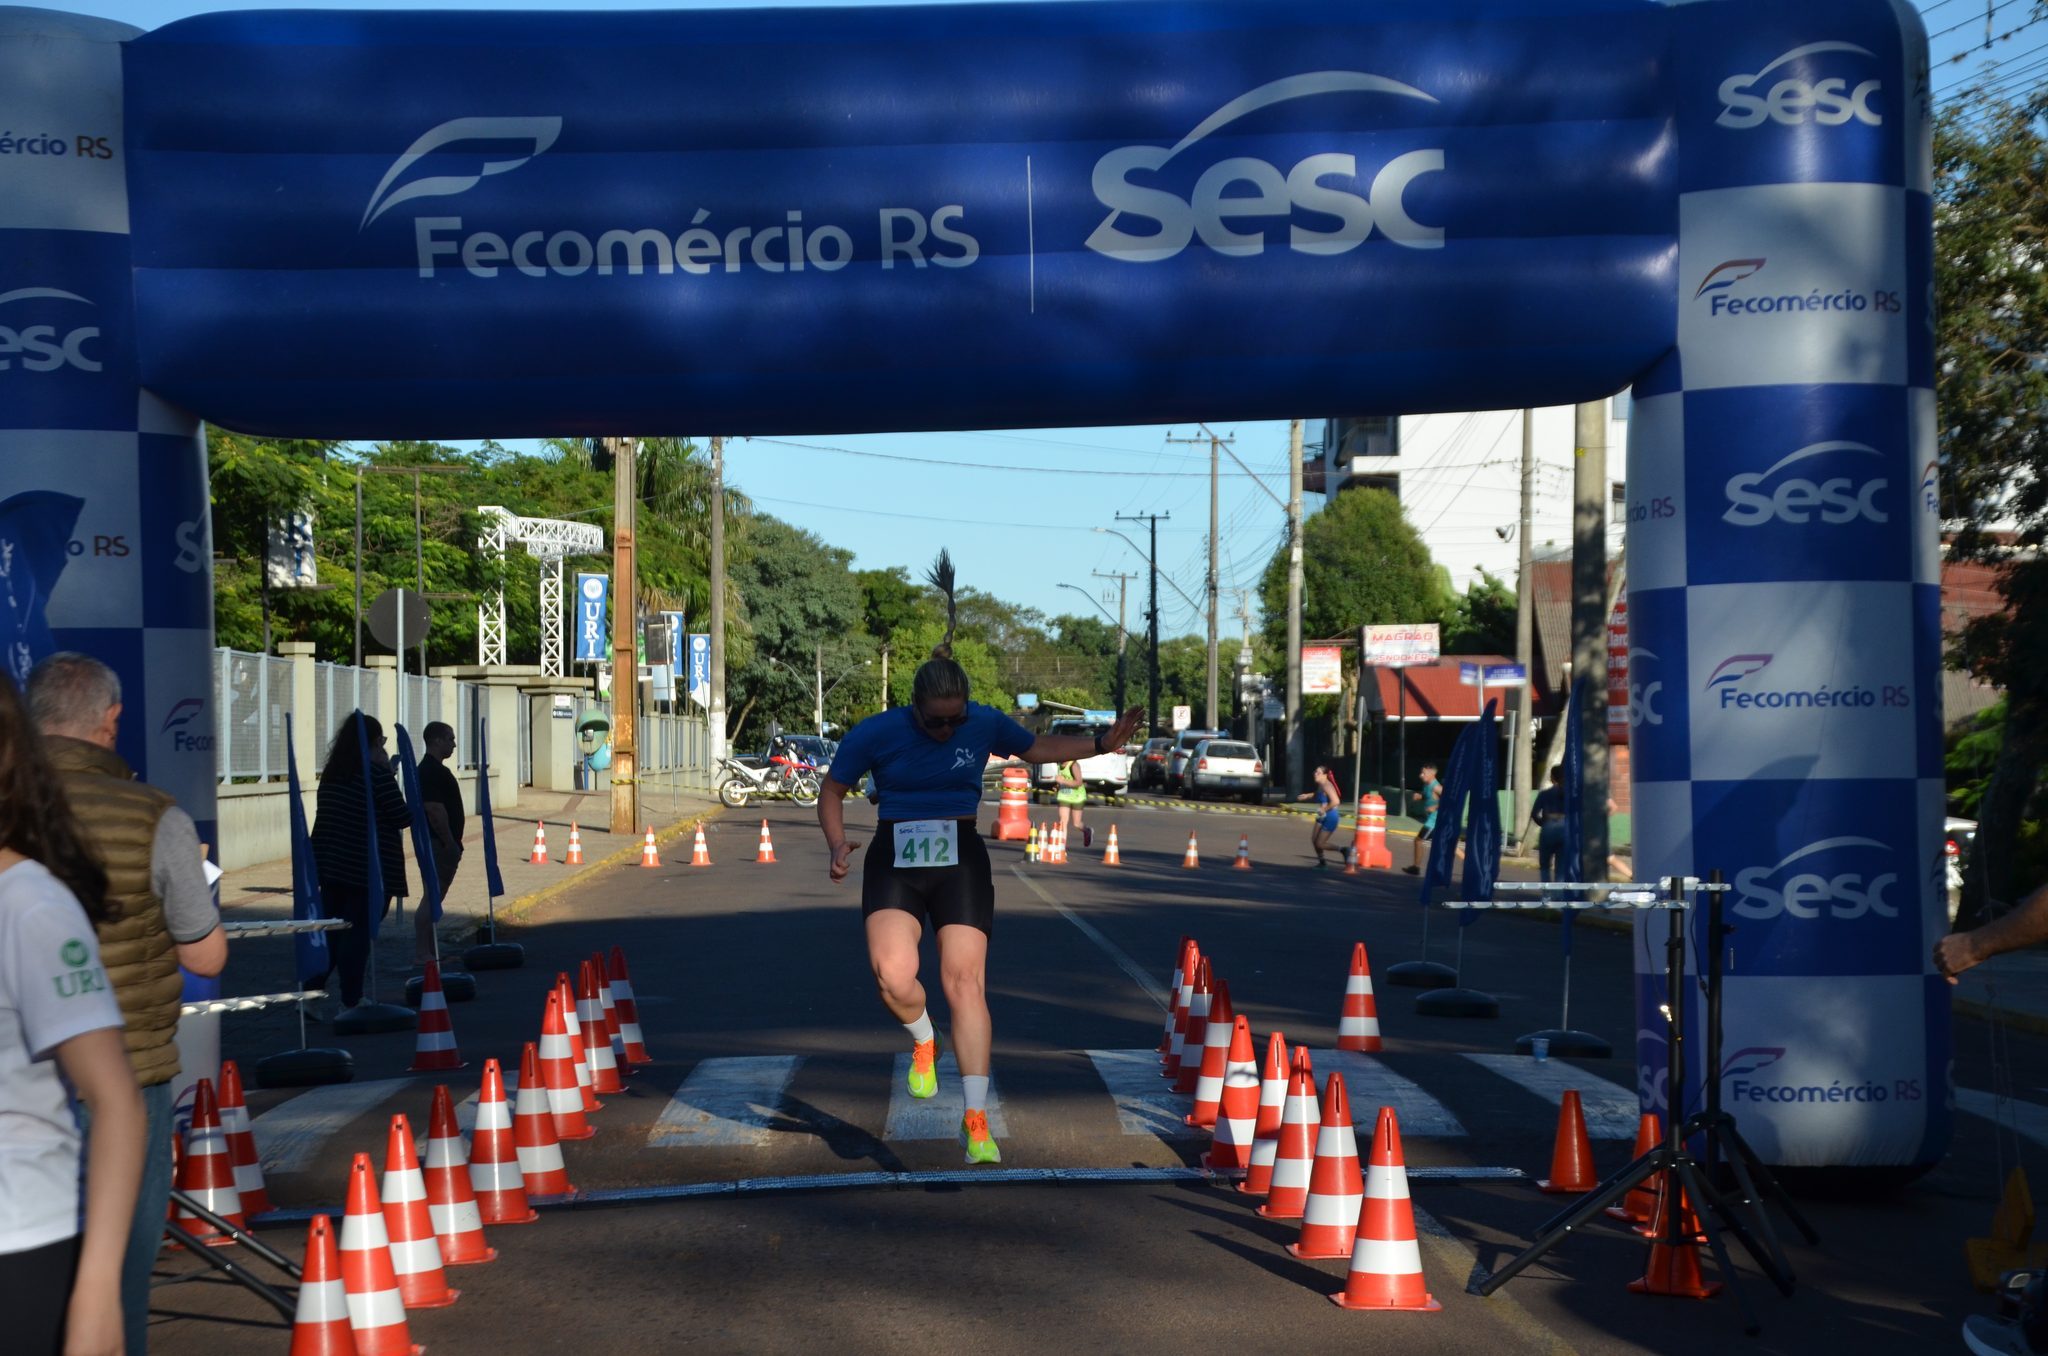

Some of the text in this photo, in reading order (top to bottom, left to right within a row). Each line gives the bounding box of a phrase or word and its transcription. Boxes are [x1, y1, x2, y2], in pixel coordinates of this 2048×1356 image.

[1714, 73, 1882, 129] Sesc
[76, 135, 114, 160] RS
[1084, 144, 1446, 263] Sesc
[413, 204, 981, 281] Fecomércio RS
[1711, 288, 1868, 317] Fecomércio
[1874, 290, 1902, 314] RS
[1651, 495, 1676, 520] RS
[1722, 472, 1889, 527] Sesc
[93, 534, 131, 558] RS
[583, 601, 602, 658] URI
[1720, 684, 1876, 709] Fecomércio
[1882, 687, 1911, 708] RS
[901, 837, 950, 863] 412
[1731, 865, 1899, 920] Sesc
[52, 967, 107, 998] URI
[1732, 1080, 1888, 1103] Fecomércio
[1894, 1079, 1922, 1101] RS
